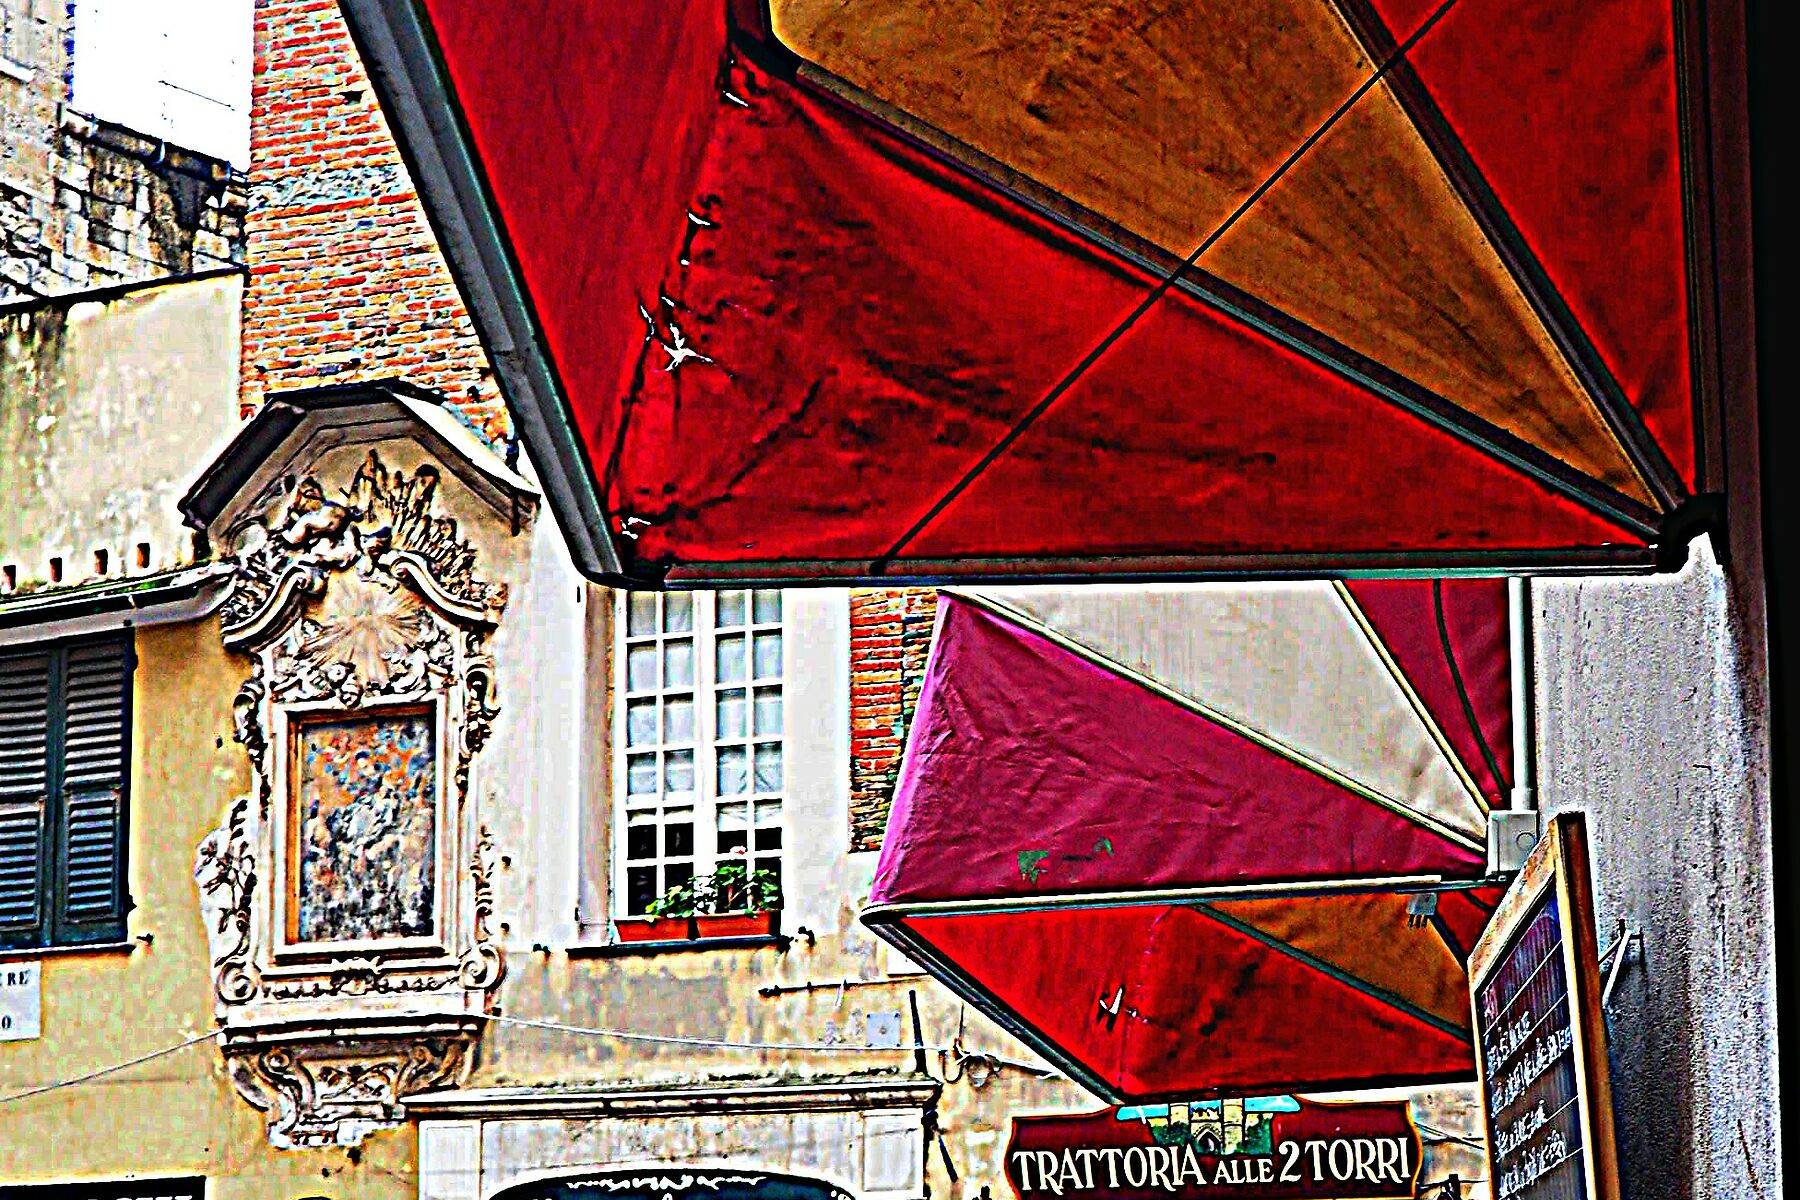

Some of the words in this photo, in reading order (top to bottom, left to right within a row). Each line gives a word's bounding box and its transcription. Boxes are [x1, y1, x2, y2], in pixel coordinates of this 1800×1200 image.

[1012, 1143, 1207, 1195] TRATTORIA
[1213, 1158, 1275, 1184] ALLE
[1279, 1140, 1301, 1183] 2
[1303, 1137, 1412, 1184] TORRI
